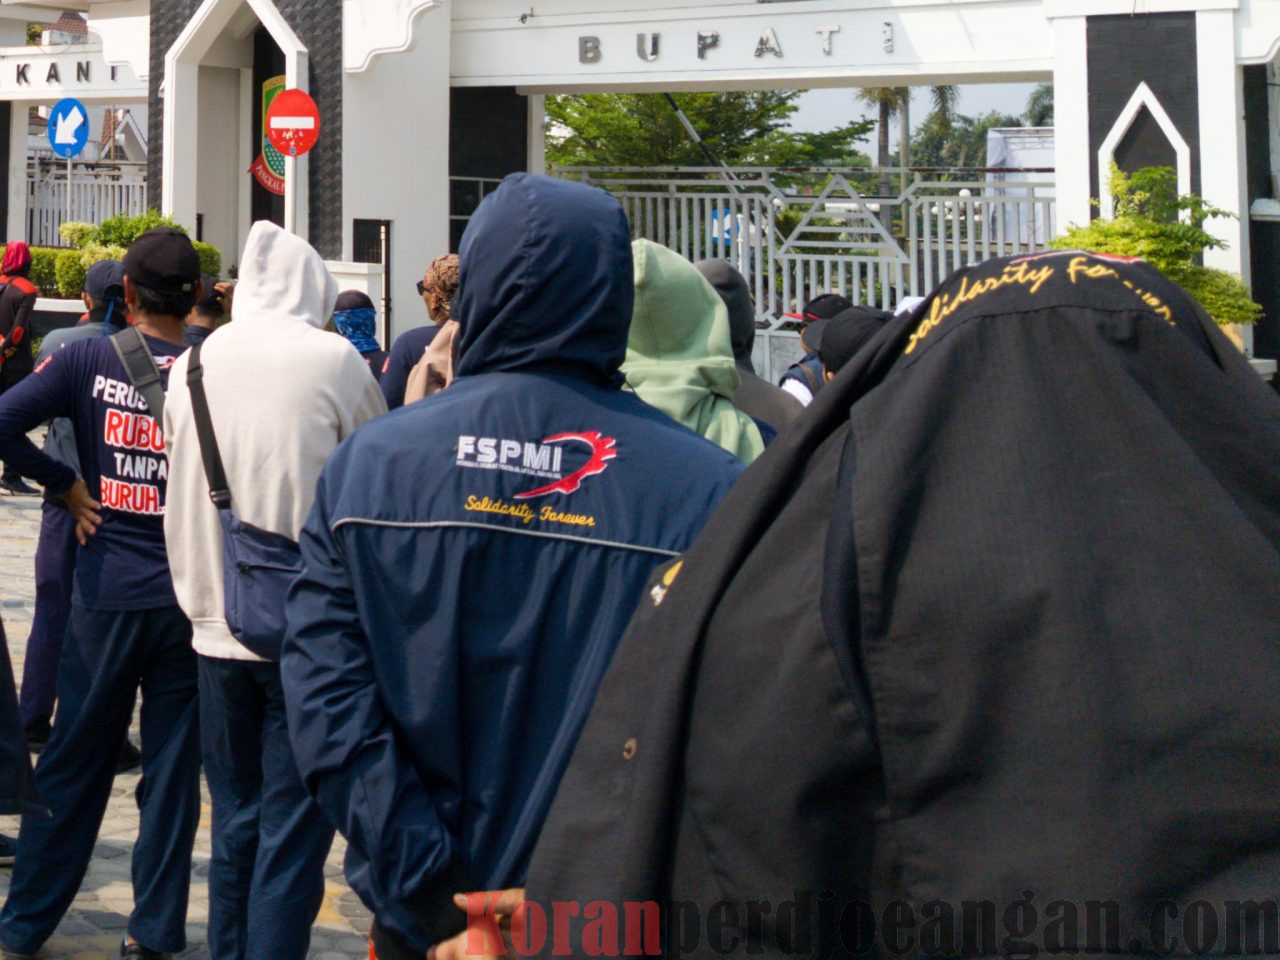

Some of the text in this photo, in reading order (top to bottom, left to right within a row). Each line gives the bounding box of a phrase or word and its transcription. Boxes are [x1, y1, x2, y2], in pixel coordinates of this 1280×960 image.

[579, 21, 895, 65] BUPATI
[113, 452, 169, 481] TANPA
[457, 435, 562, 472] FSPMI
[464, 494, 596, 527] Solidarity Forever
